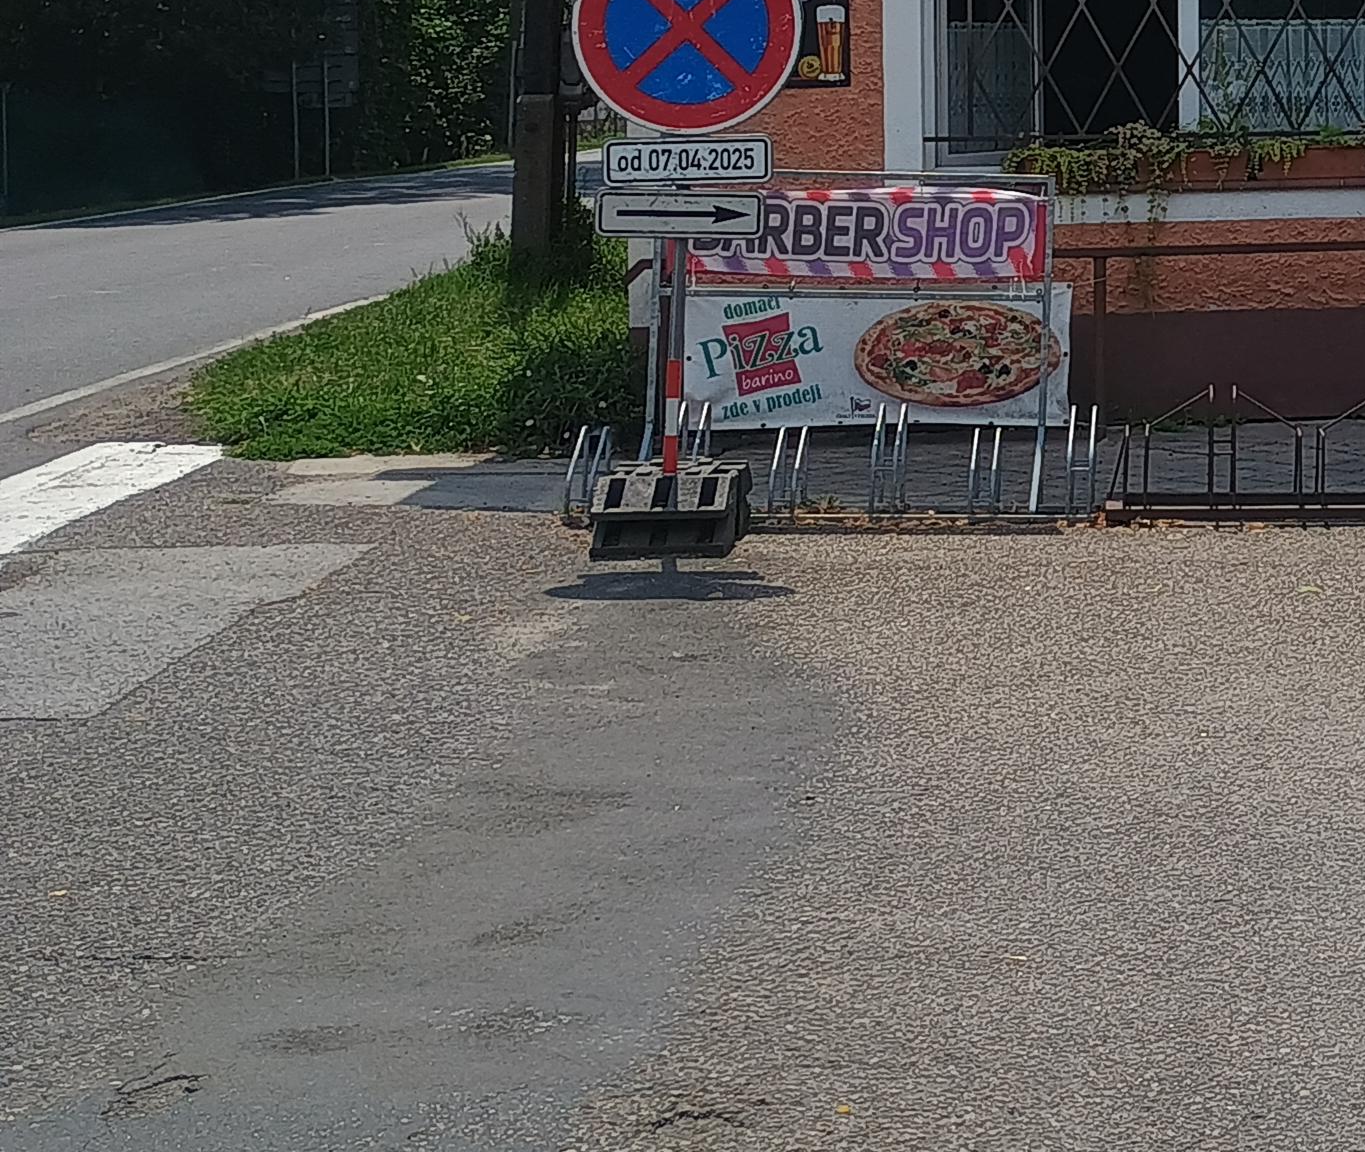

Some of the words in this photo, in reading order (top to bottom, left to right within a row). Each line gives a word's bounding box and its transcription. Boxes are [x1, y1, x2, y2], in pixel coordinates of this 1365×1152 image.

[617, 149, 642, 172] od
[649, 148, 755, 171] 07.04.2025
[693, 202, 886, 256] RBER
[892, 202, 1030, 258] SHOP
[696, 326, 824, 380] Pizza
[742, 370, 793, 390] barino
[722, 402, 749, 421] zde
[752, 400, 761, 413] v
